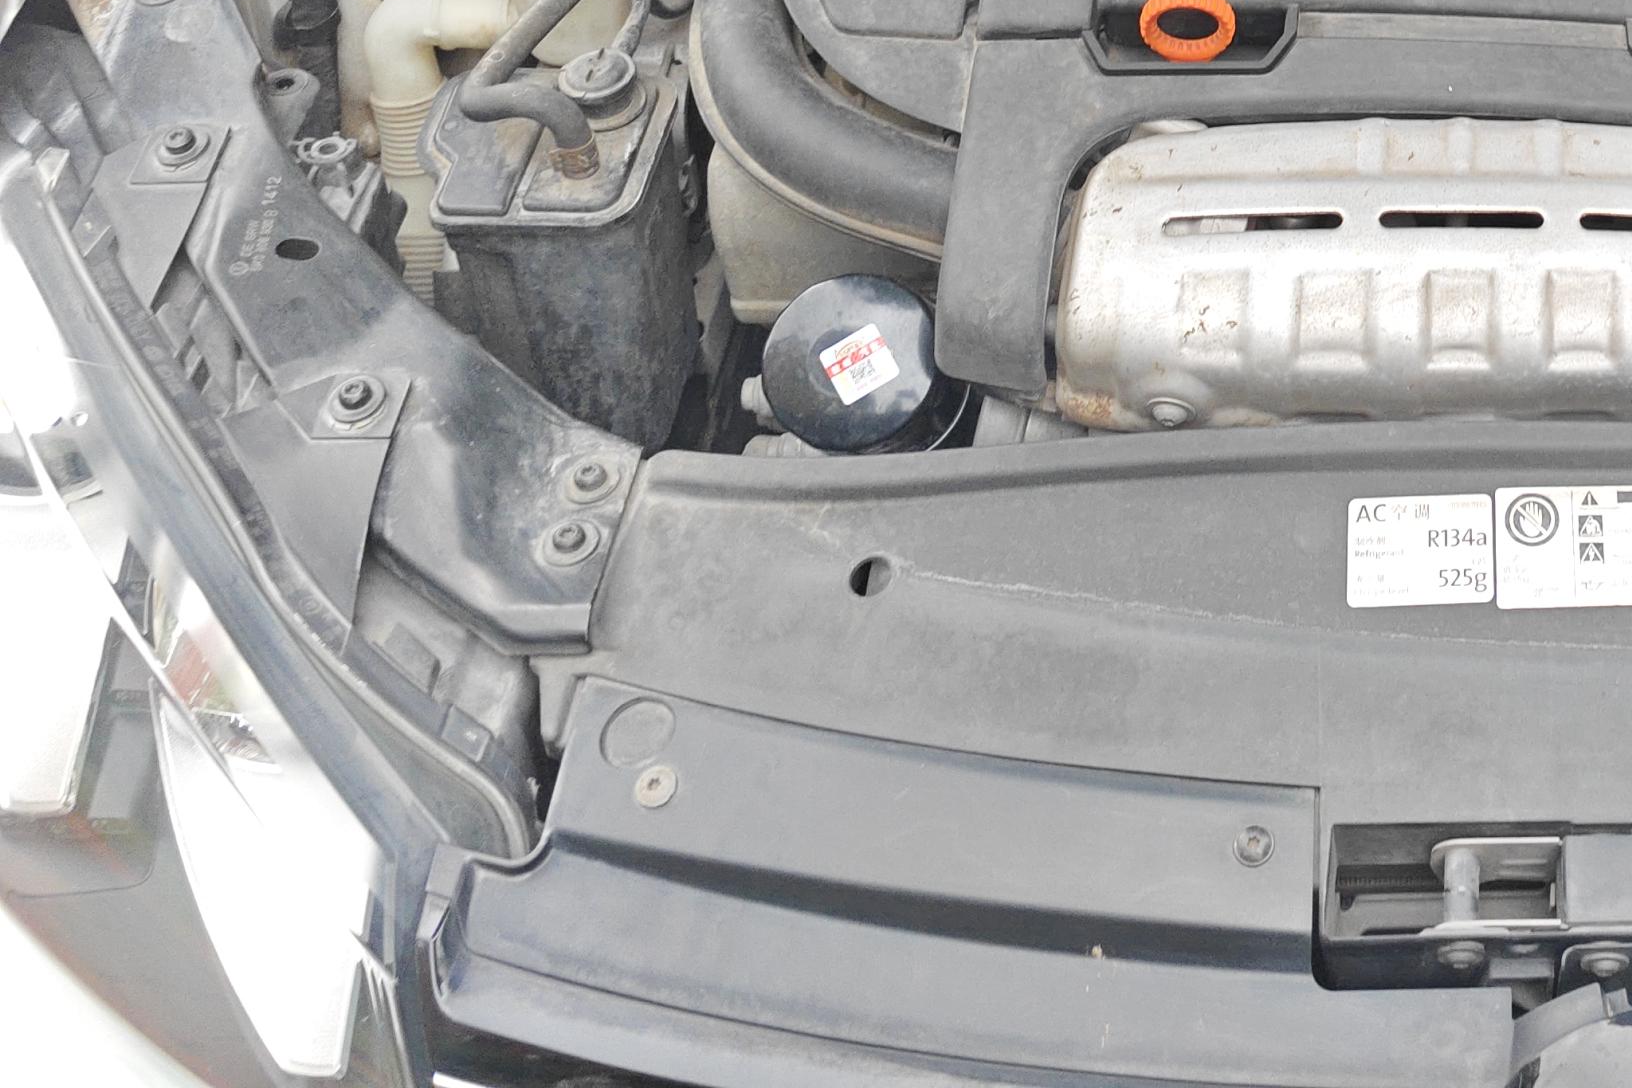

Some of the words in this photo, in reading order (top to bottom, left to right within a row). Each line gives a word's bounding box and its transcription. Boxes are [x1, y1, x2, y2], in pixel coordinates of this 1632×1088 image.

[1356, 503, 1387, 523] AC
[1427, 528, 1488, 548] R134a
[1438, 568, 1488, 593] 525g
